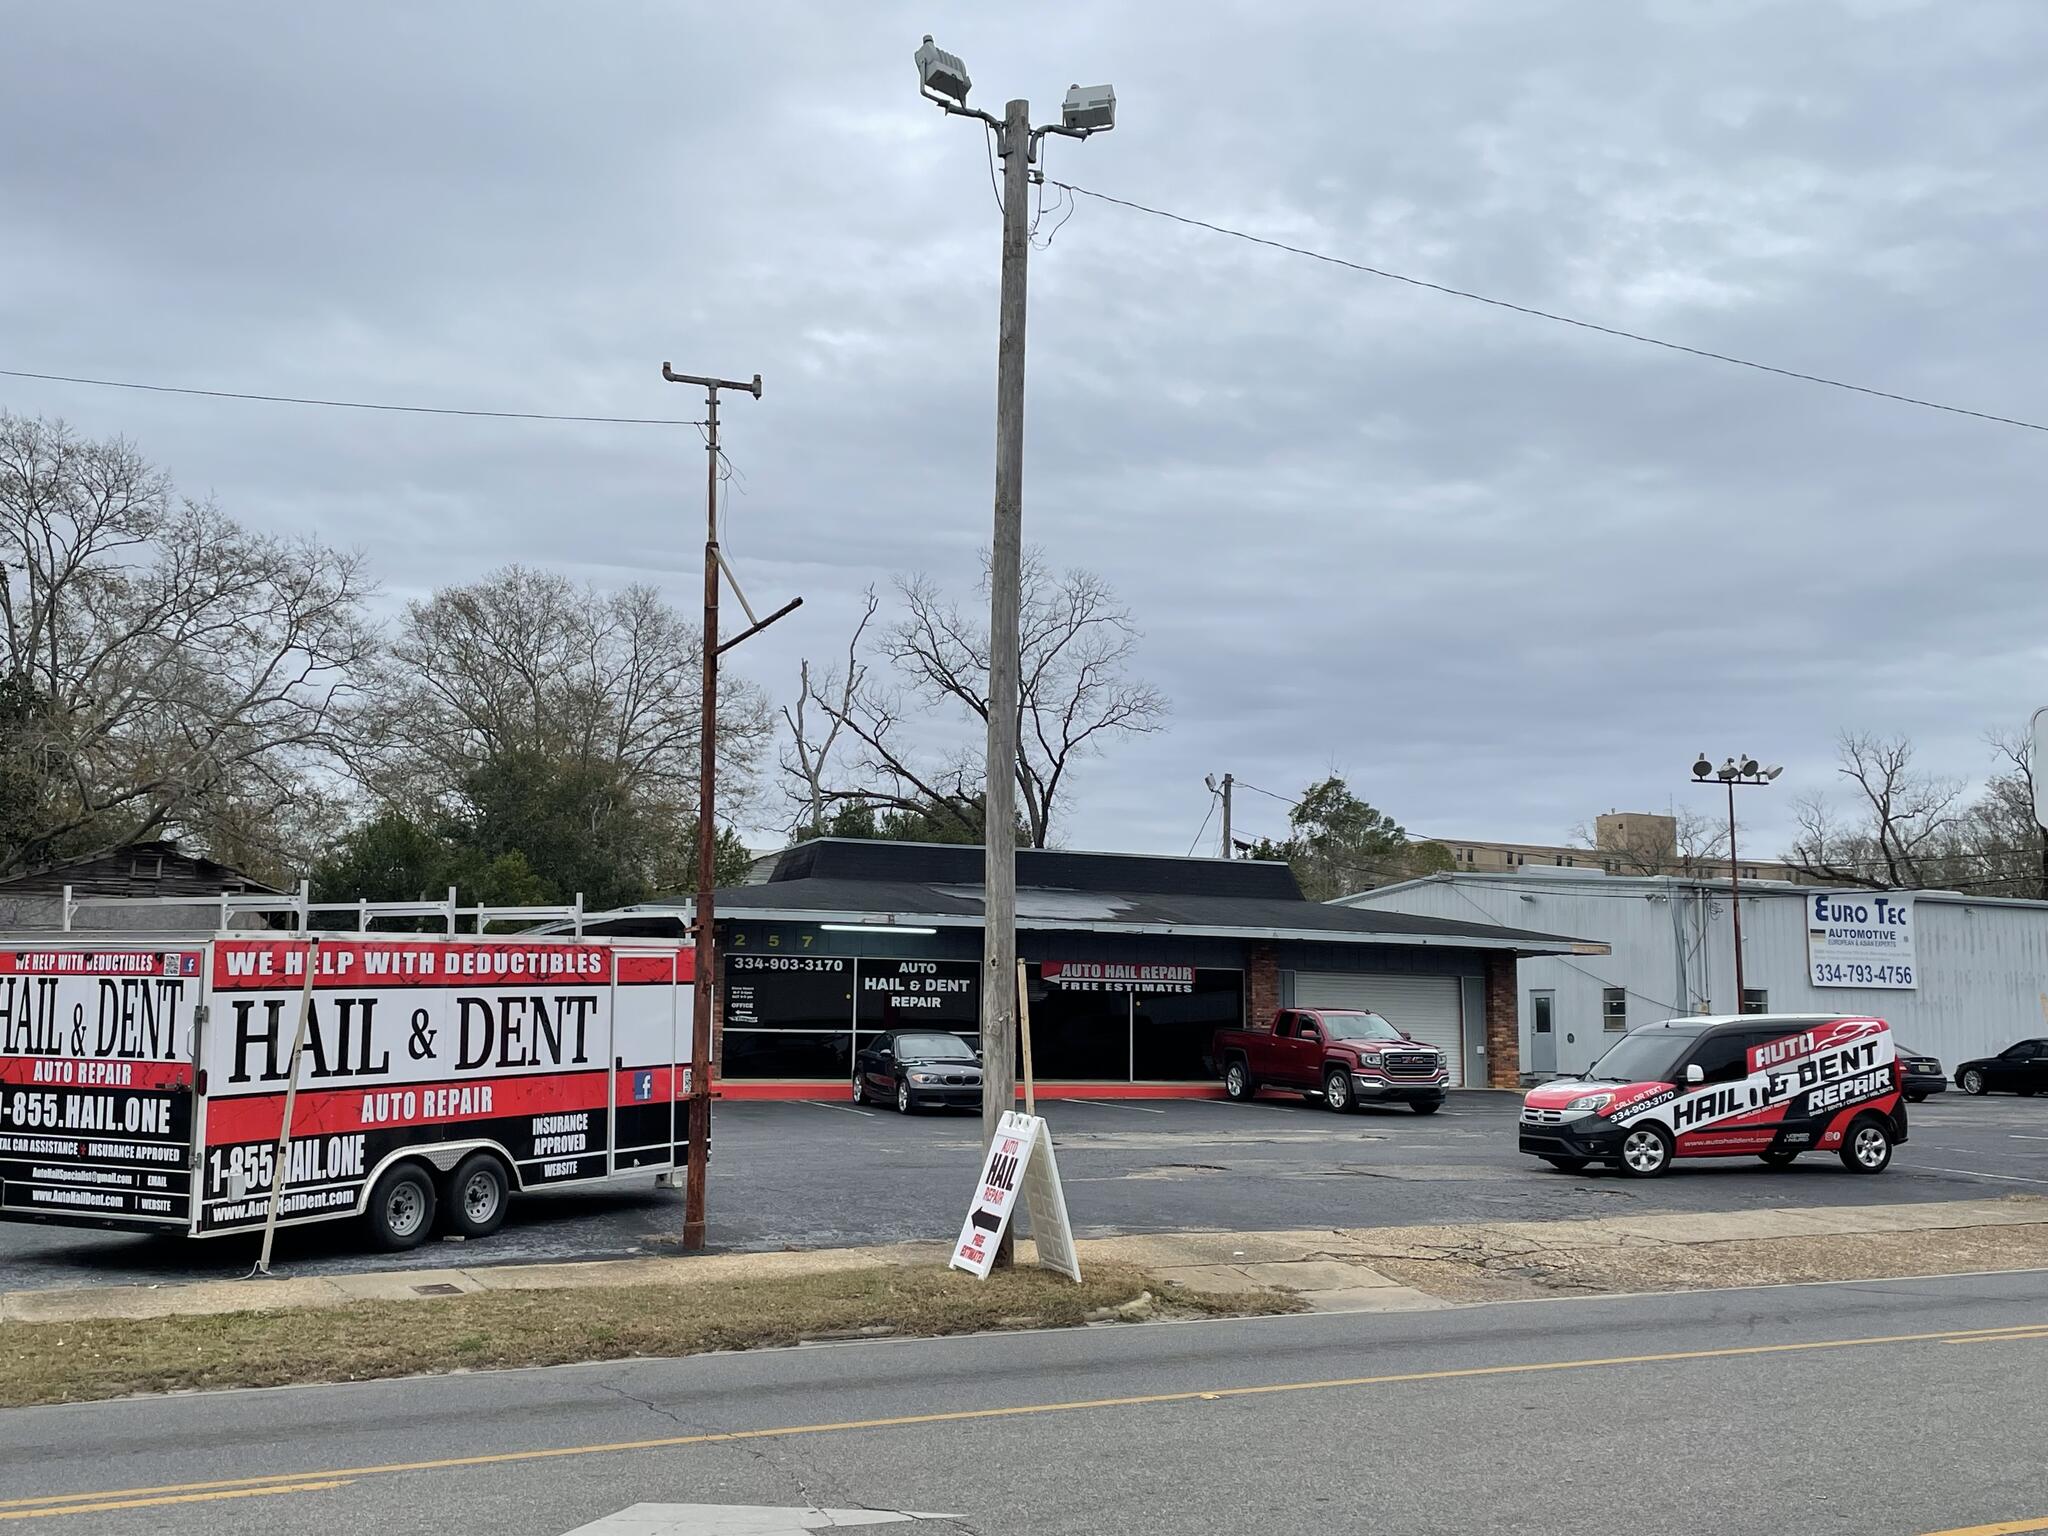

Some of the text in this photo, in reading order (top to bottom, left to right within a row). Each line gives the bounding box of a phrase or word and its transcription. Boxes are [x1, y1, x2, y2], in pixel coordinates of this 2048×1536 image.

[735, 935, 813, 948] 2 5 7
[1828, 929, 1896, 940] AUTOMOTIVE
[15, 953, 153, 972] WE HELP WITH DEDUCTIBLES
[226, 951, 273, 976] WE
[364, 951, 435, 975] WITH
[445, 952, 601, 974] DEDUCTIBLES
[734, 957, 843, 971] 334-903-3170
[898, 962, 937, 974] AUTO
[1061, 963, 1192, 980] AUTO HAIL REPAIR
[1815, 963, 1912, 984] 334-793-4756
[864, 977, 970, 992] HAIL & DENT
[1061, 981, 1193, 993] FREE ESTIMATES
[891, 996, 942, 1008] REPAIR
[0, 977, 184, 1059] HAIL & DENT
[228, 995, 598, 1083] HAIL & DENT
[1756, 1032, 1815, 1068] AUTO
[33, 1060, 132, 1087] AUTO REPAIR
[1674, 1088, 1744, 1130] HAIL
[1798, 1040, 1878, 1088] DENT
[1614, 1085, 1662, 1110] CALL OR TEXT
[1808, 1067, 1892, 1110] REPAIR
[361, 1086, 494, 1124] AUTO REPAIR
[1610, 1091, 1675, 1123] 334-903-3170
[532, 1113, 589, 1136] INSURANCE
[13, 1138, 29, 1152] CAR
[29, 1139, 79, 1155] ASSISTANCE
[88, 1143, 135, 1159] INSURANCE
[136, 1146, 180, 1162] APPROVED
[534, 1134, 586, 1156] APPROVED
[1001, 1138, 1019, 1155] AUTO
[1684, 1137, 1774, 1147] www.autohaildent.com
[210, 1134, 366, 1193] 1-855HAIL.ONE
[544, 1161, 578, 1177] WEBSITE
[985, 1152, 1019, 1191] HAIL
[147, 1175, 168, 1188] EMAIL
[32, 1189, 124, 1208] www.AutoHailDent.com
[141, 1198, 171, 1212] WEBSITE
[213, 1189, 354, 1222] www.AutHailDent.com
